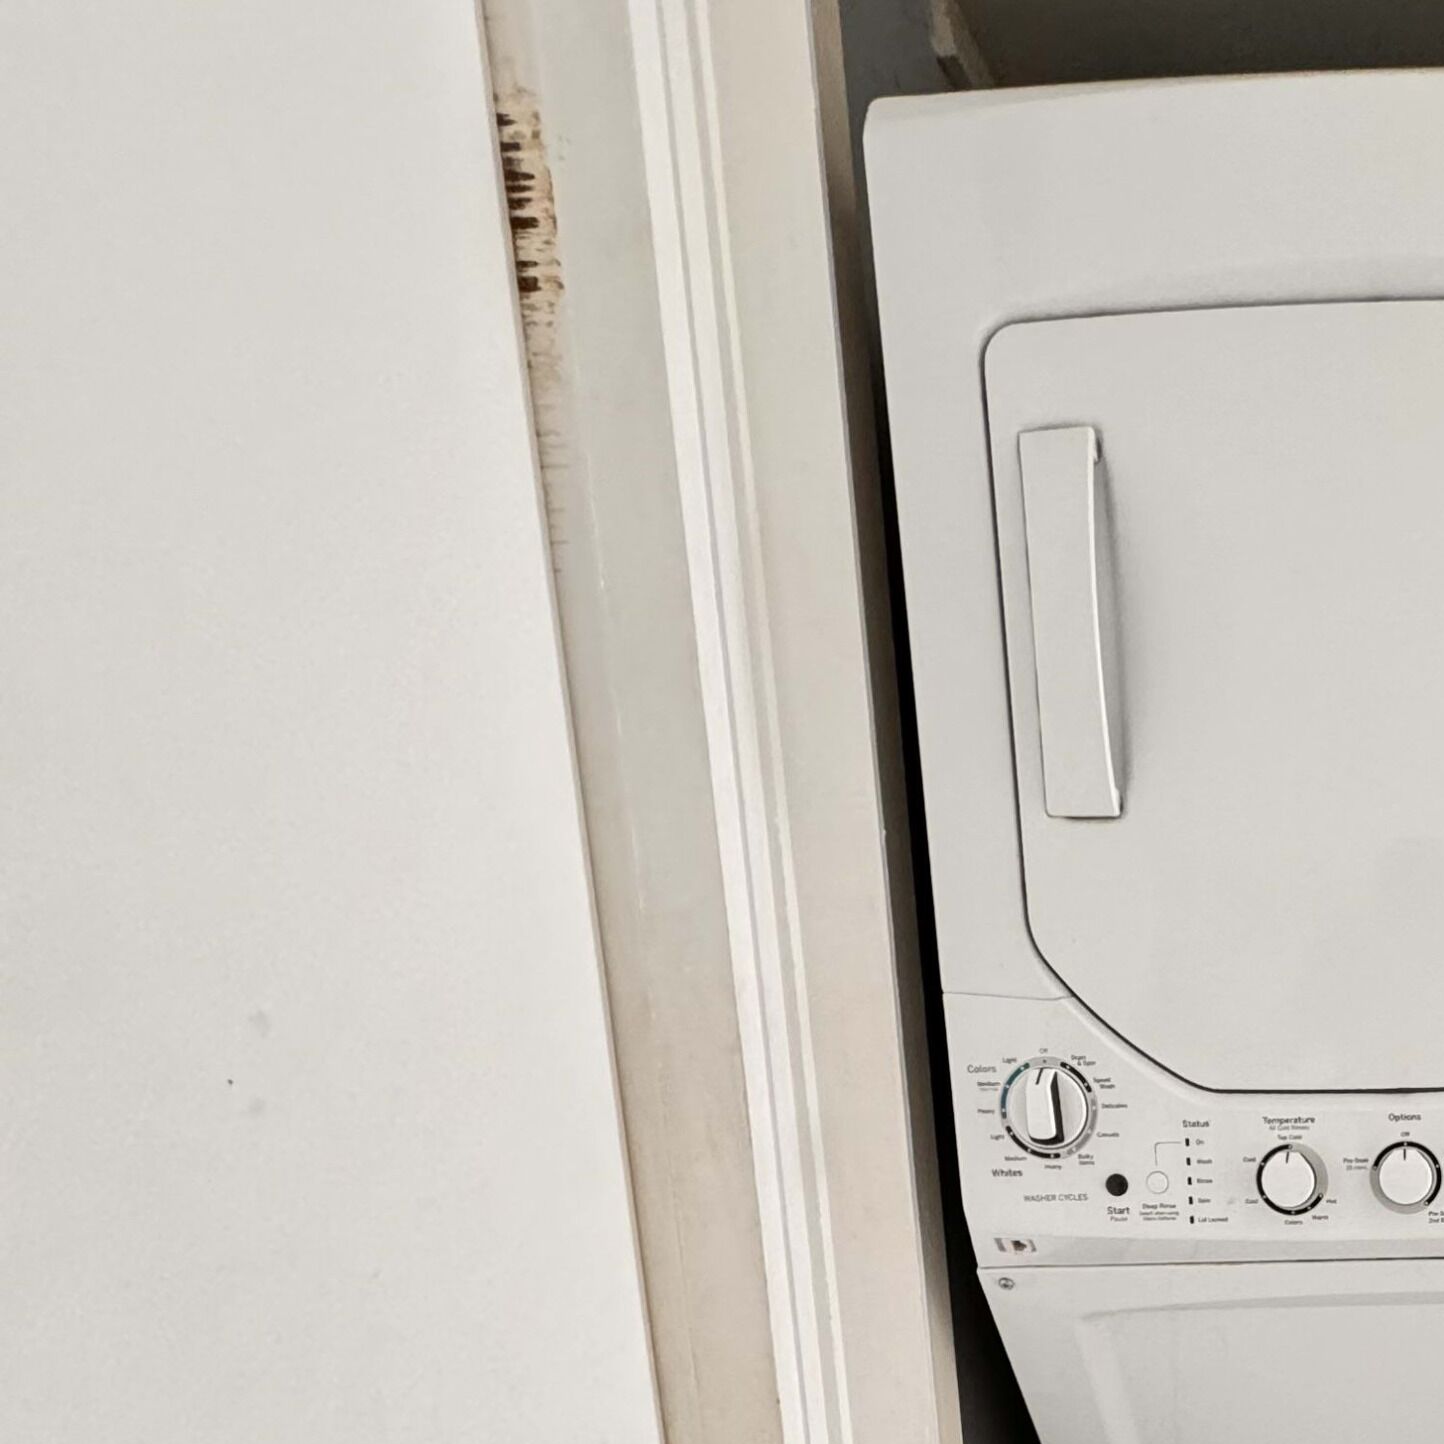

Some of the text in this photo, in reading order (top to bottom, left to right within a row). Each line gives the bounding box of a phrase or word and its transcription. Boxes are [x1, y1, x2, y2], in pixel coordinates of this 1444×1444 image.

[1002, 1056, 1018, 1064] Light
[967, 1064, 998, 1074] Colors
[1262, 1116, 1316, 1125] Temperature
[1388, 1113, 1422, 1122] Options
[1182, 1120, 1210, 1128] Status
[992, 1169, 1023, 1178] Whites
[1024, 1193, 1088, 1202] WASHER CYCLES
[1107, 1206, 1130, 1215] Start
